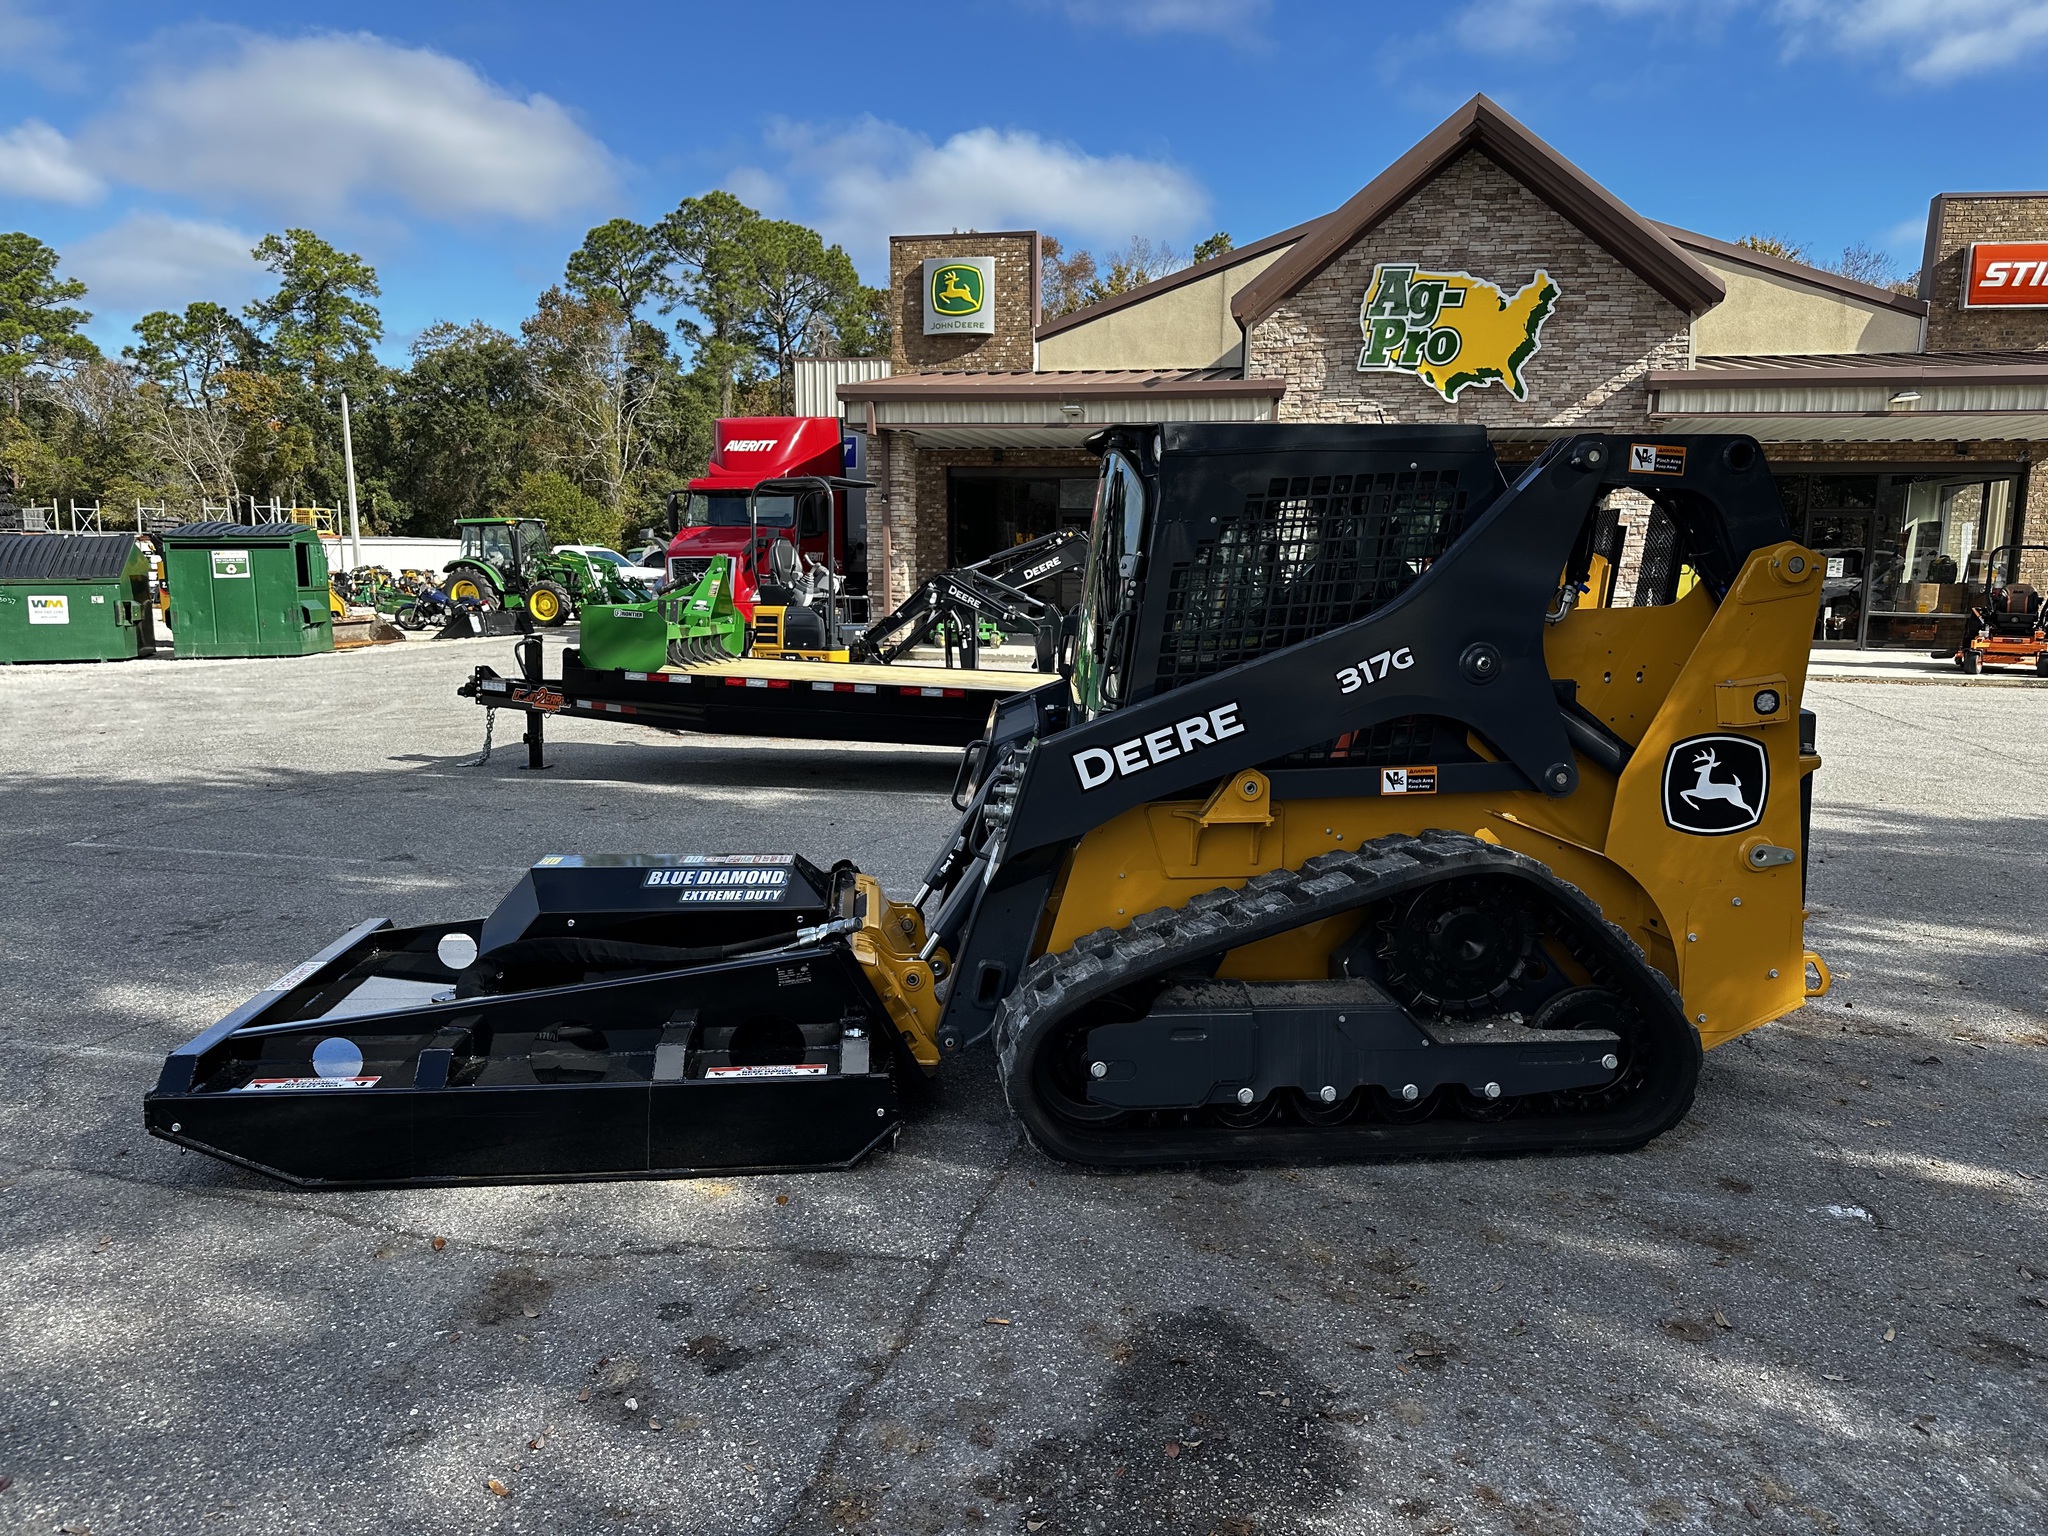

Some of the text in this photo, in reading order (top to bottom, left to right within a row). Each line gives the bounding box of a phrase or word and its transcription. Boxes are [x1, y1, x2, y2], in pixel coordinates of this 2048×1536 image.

[1979, 261, 2048, 287] STI
[1366, 267, 1466, 328] Ag-
[931, 320, 985, 330] JOHN DEERE
[1361, 318, 1461, 367] Pro
[723, 439, 778, 452] AVERITT
[1023, 556, 1062, 580] DEERE
[31, 599, 64, 608] WM
[948, 585, 982, 609] DEERE
[1335, 647, 1415, 694] 317G
[1072, 702, 1245, 791] DEERE
[647, 870, 695, 885] BLUE
[681, 889, 783, 901] EXTREME DUTY
